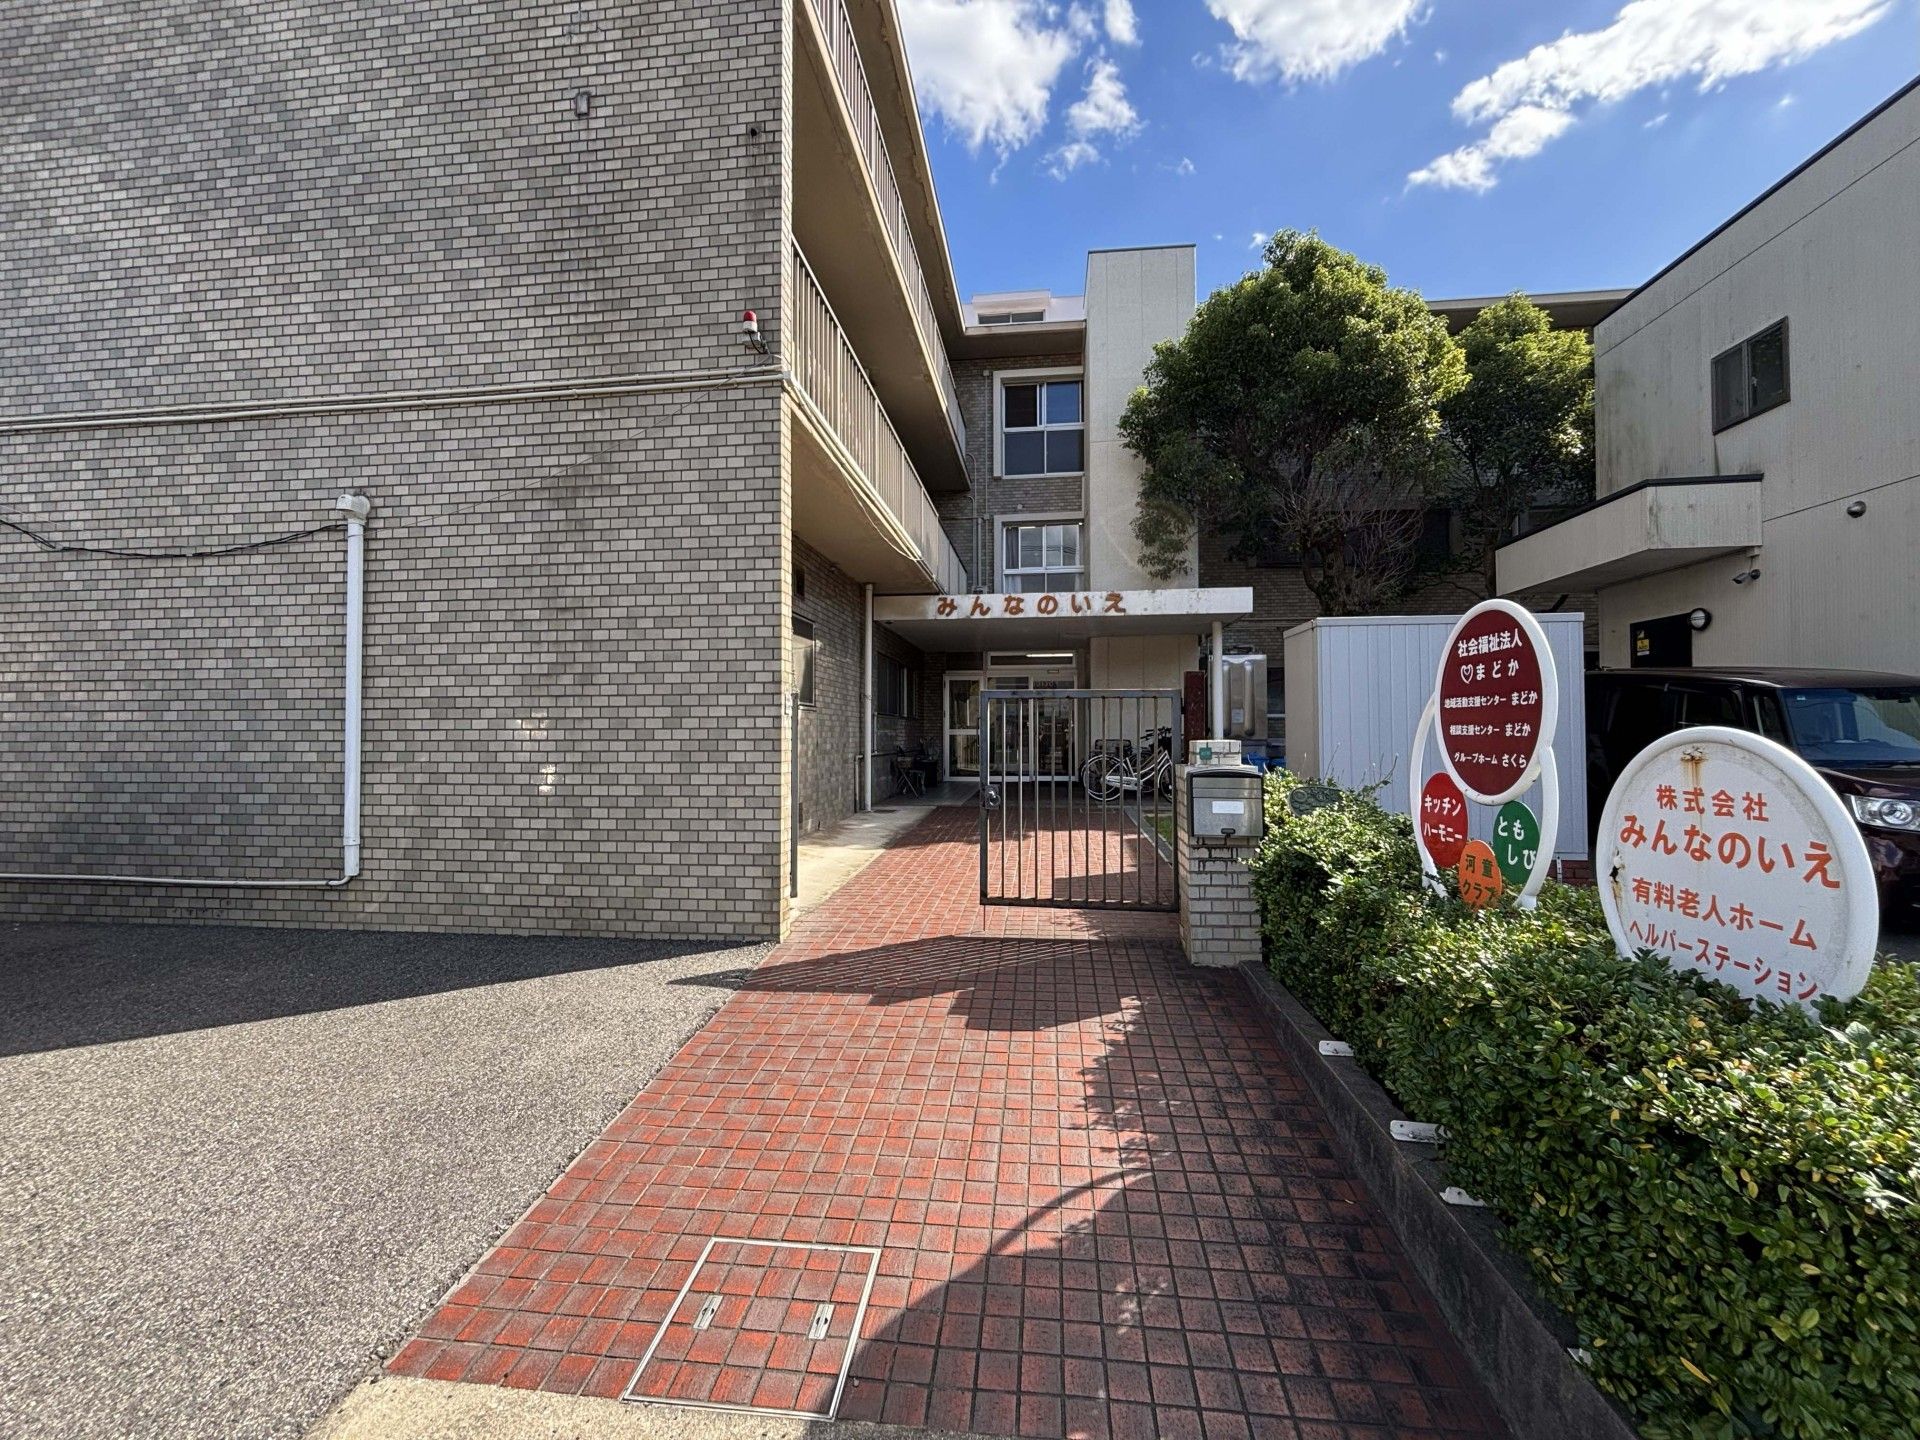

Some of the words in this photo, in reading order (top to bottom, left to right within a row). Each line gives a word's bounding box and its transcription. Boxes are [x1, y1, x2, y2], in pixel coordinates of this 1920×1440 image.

[937, 592, 1126, 617] みんなのいえ
[1457, 628, 1522, 657] 社会福祉法人
[1476, 658, 1519, 680] まどか
[1444, 694, 1507, 709] 地域活動支援センター
[1511, 690, 1538, 706] まどか
[1449, 724, 1500, 736] 相談支援センター
[1504, 722, 1531, 737] まどか
[1454, 751, 1498, 765] グループホーム
[1502, 753, 1527, 769] さくら
[1424, 794, 1462, 817] キッチン
[1656, 784, 1769, 823] 株式会社
[1423, 822, 1463, 842] ハーモニー
[1619, 814, 1841, 889] みんなのいえ
[1631, 877, 1818, 951] 有料老人ホーム
[1629, 919, 1819, 1000] ヘルパーステーション
